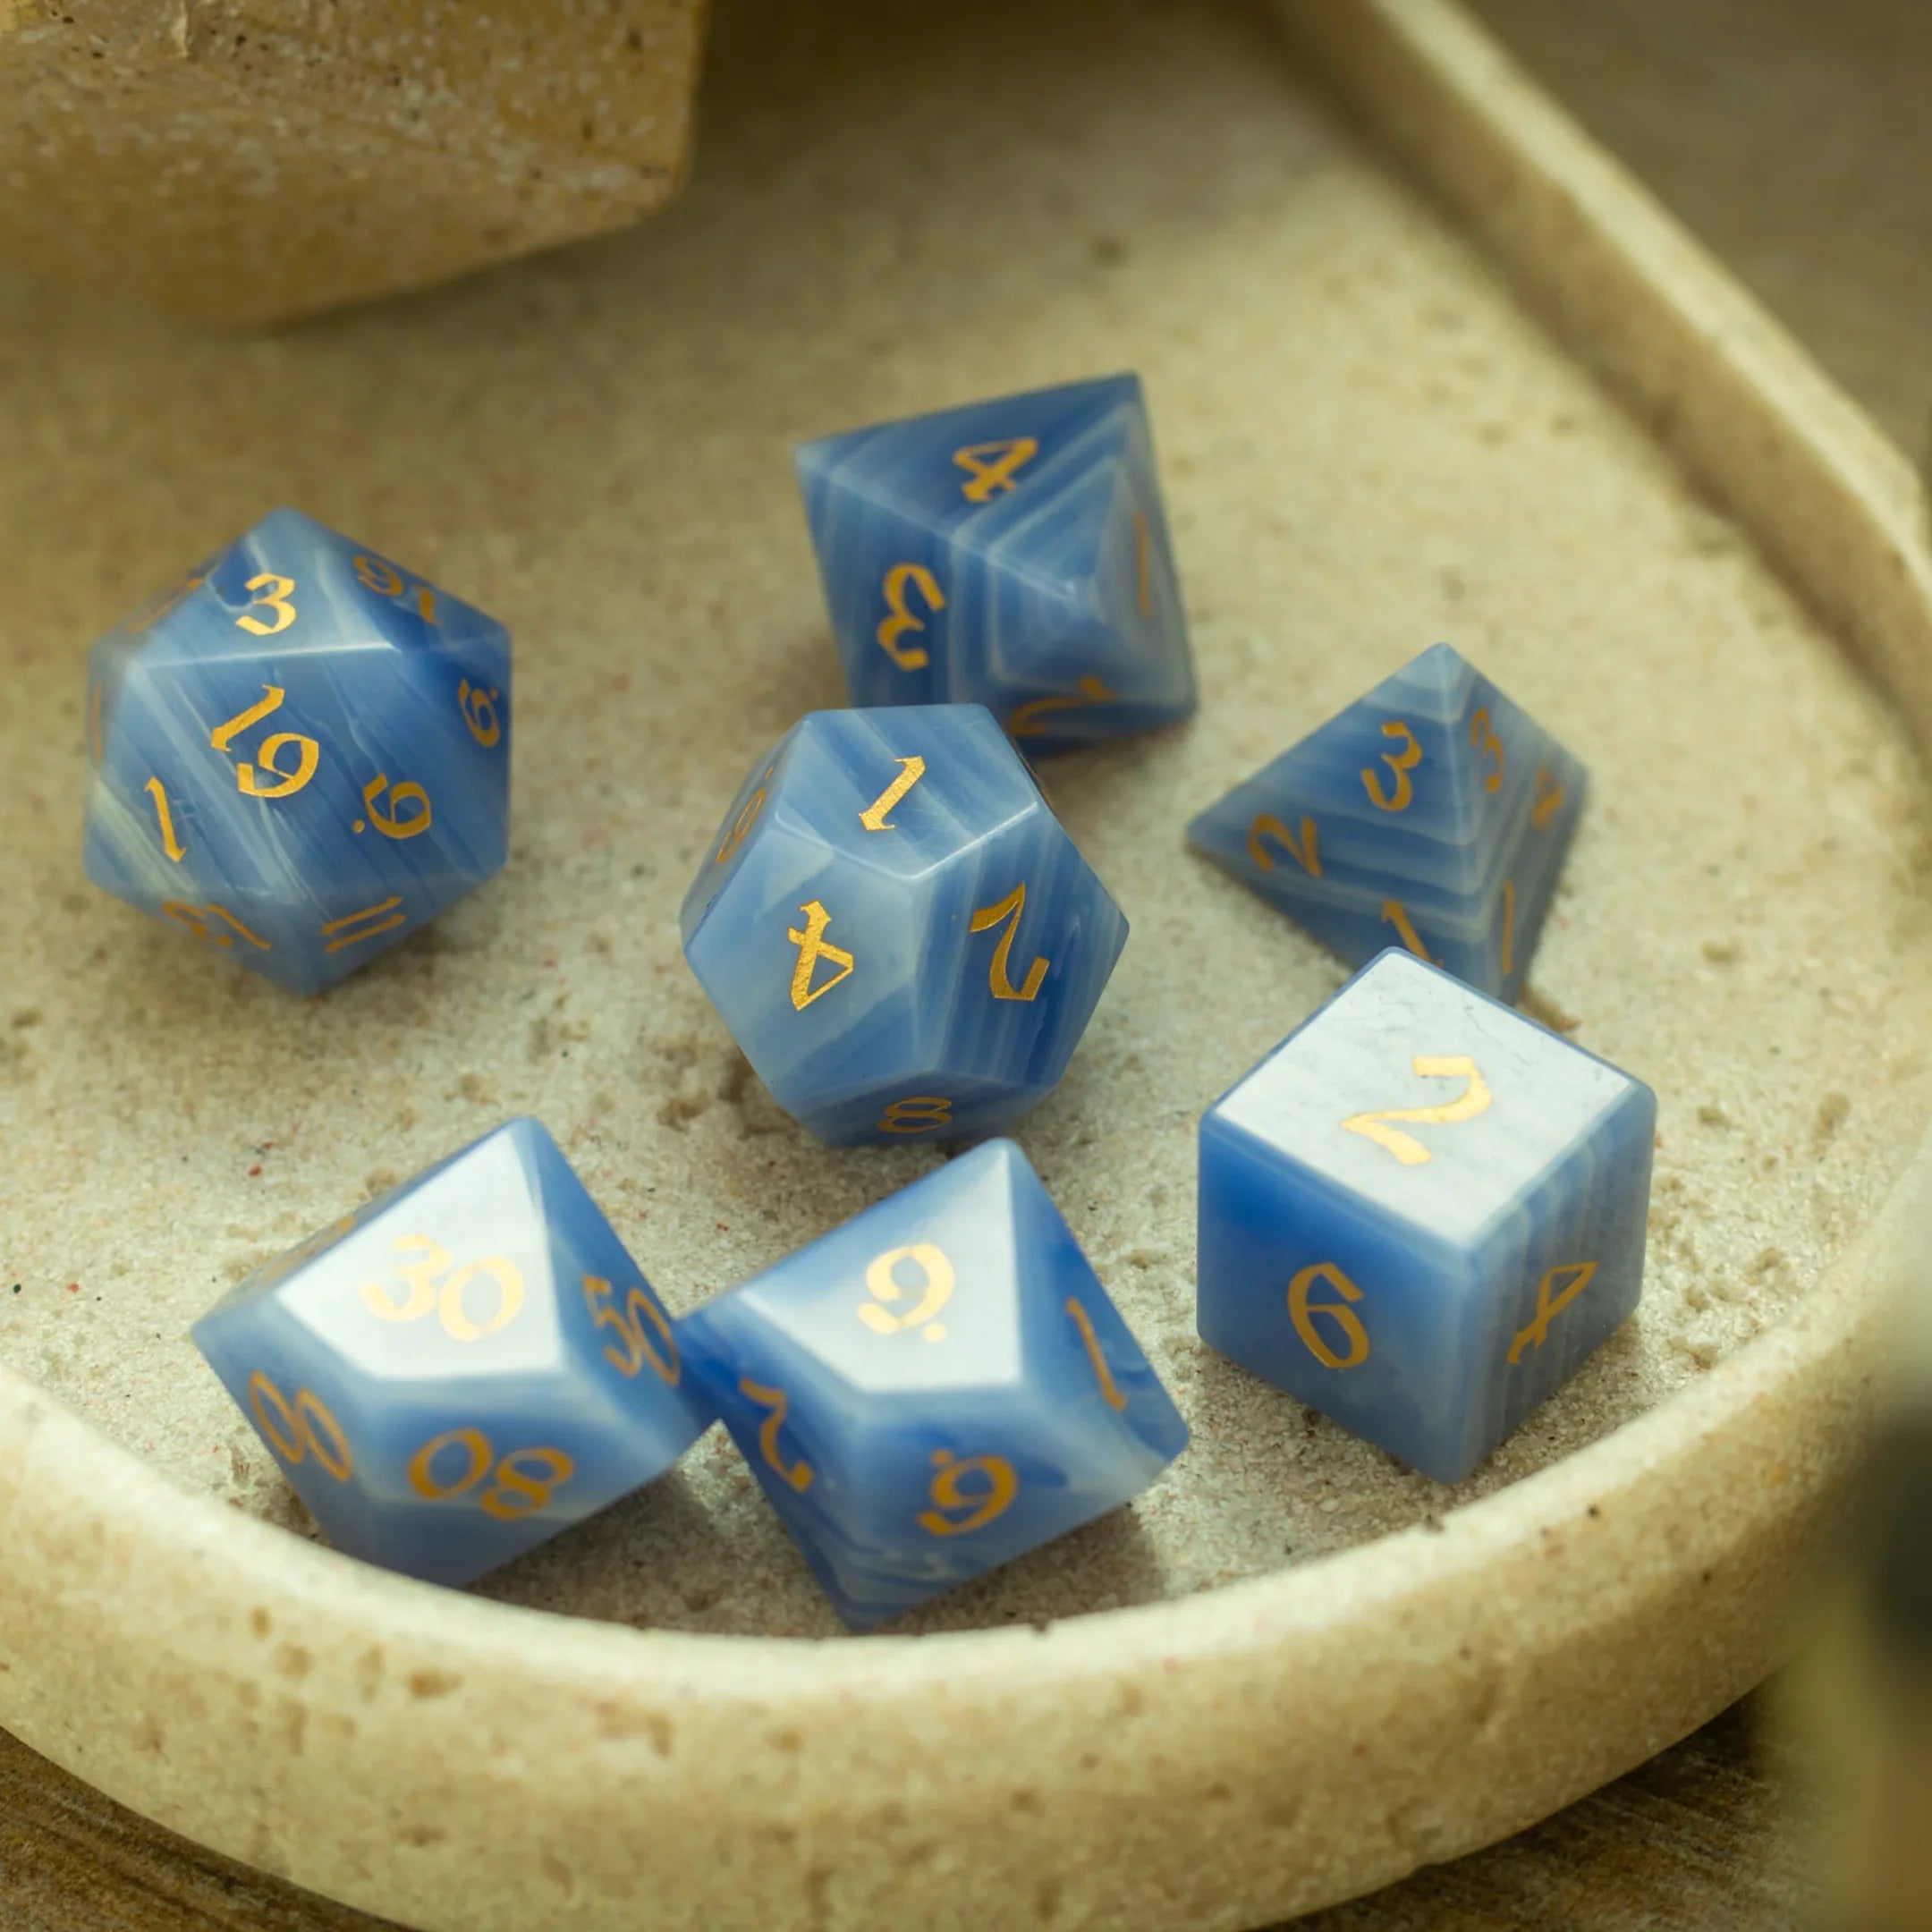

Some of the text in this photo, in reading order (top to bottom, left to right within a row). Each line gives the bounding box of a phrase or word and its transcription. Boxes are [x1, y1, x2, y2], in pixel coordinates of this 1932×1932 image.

[953, 437, 1038, 503] 4
[236, 572, 296, 635] 3
[877, 562, 946, 672] 3
[211, 684, 318, 798] 19
[1360, 721, 1422, 811] 3
[1470, 707, 1504, 792] 3
[144, 775, 186, 862] 1
[858, 756, 926, 830] 1
[1247, 814, 1323, 877] 2
[788, 900, 854, 1011] 4
[970, 882, 1049, 1001] 2
[1381, 900, 1443, 969] 1
[877, 1097, 953, 1133] 8
[1341, 1056, 1492, 1165] 2
[363, 1233, 525, 1342] 30
[580, 1275, 681, 1387] 50
[1287, 1262, 1369, 1368] 6
[1506, 1261, 1600, 1364] 4
[1064, 1298, 1127, 1413] 1
[250, 1369, 352, 1485] 00
[408, 1426, 574, 1521] 80
